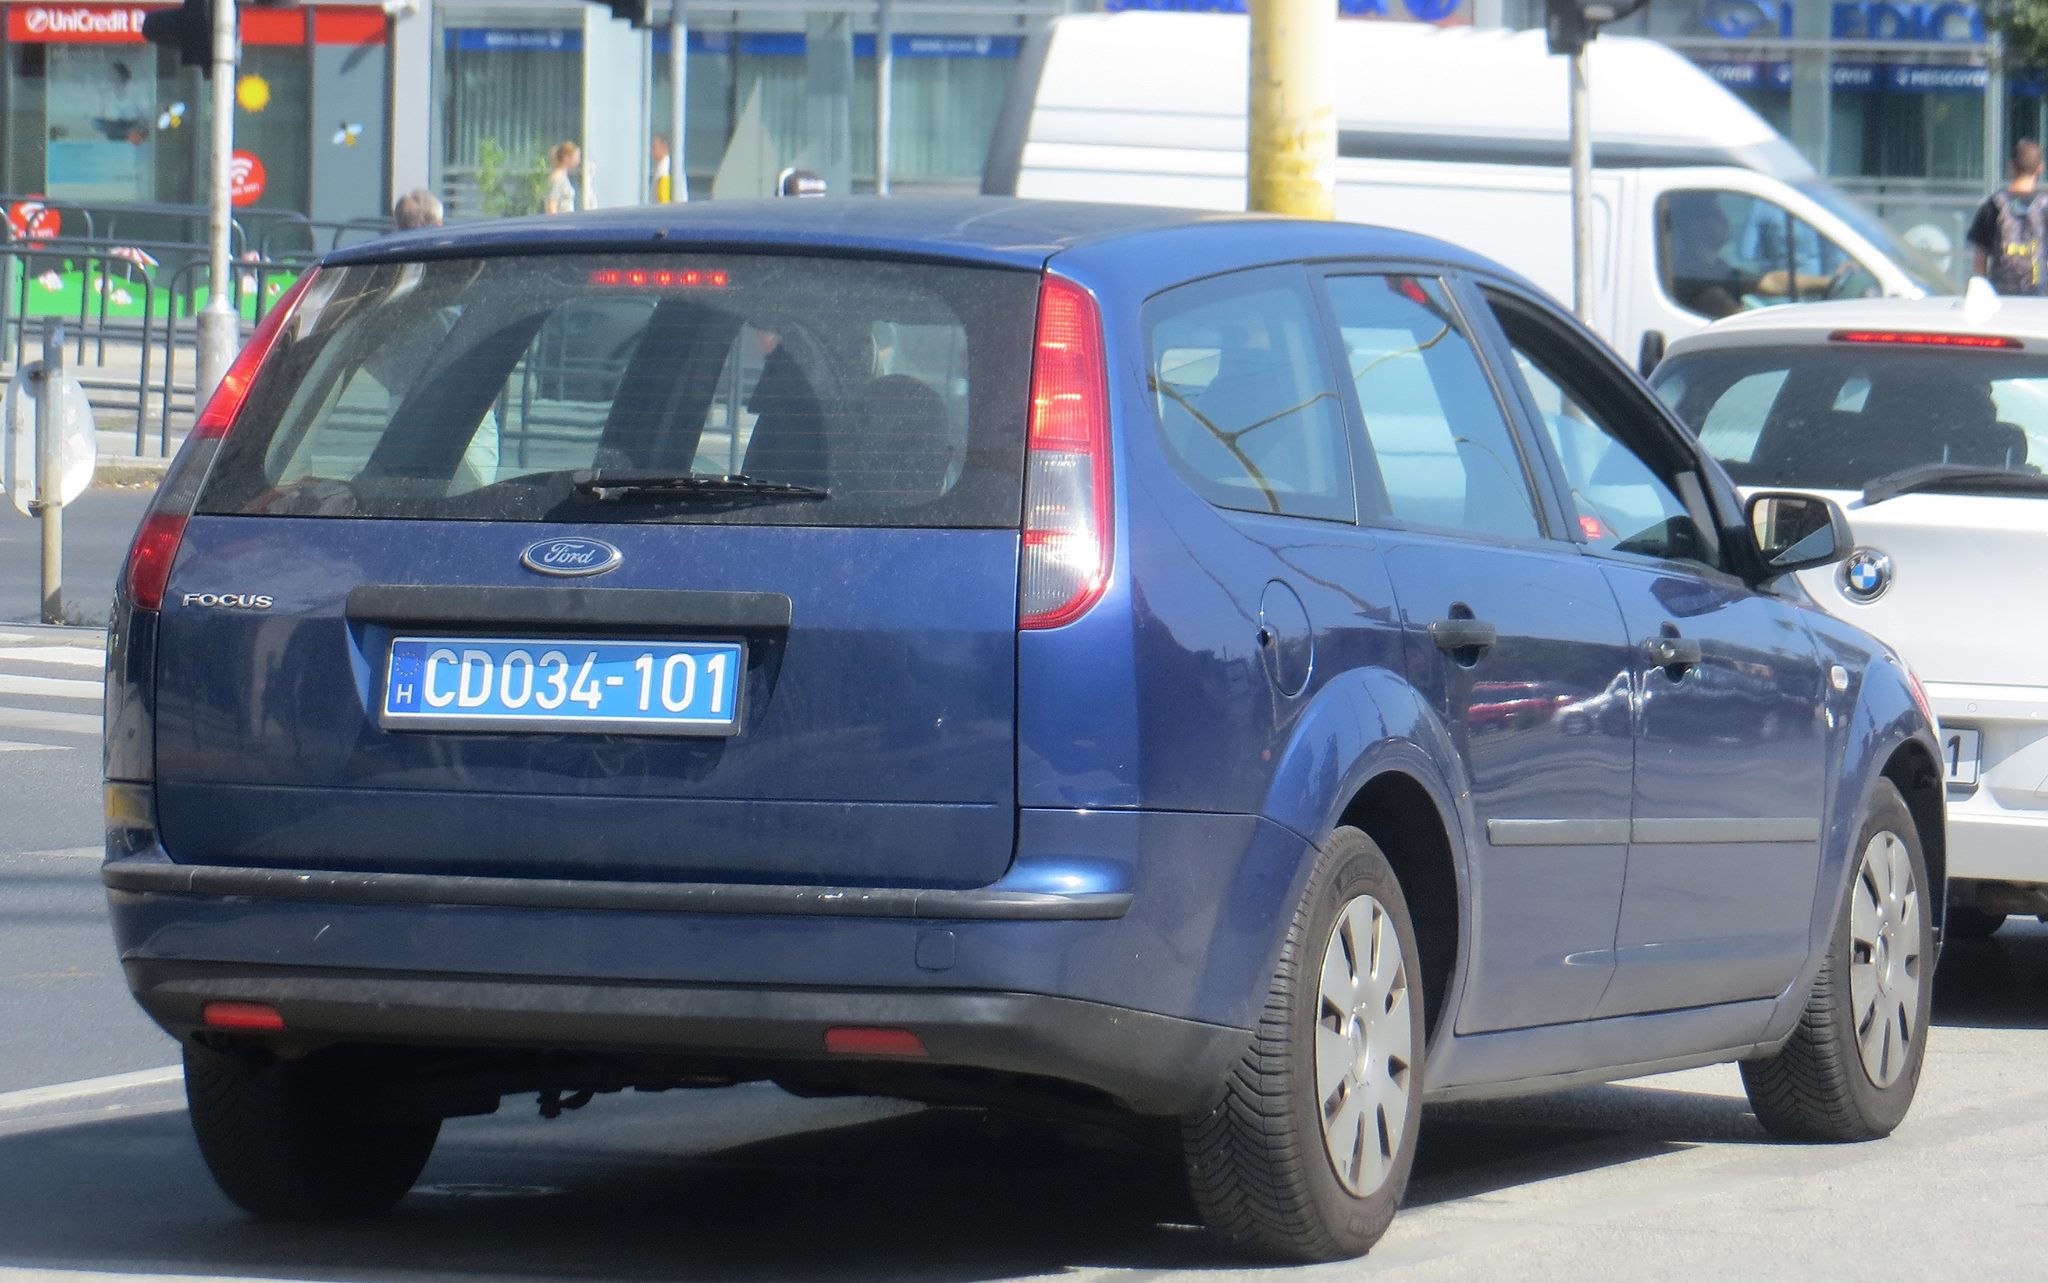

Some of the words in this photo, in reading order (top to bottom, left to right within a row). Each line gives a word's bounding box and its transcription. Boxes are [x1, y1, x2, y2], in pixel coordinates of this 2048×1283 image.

[48, 9, 128, 32] UniCredit
[544, 543, 595, 564] Ford
[182, 592, 274, 608] FOCUS
[424, 648, 727, 713] CD034-101
[396, 683, 413, 704] H
